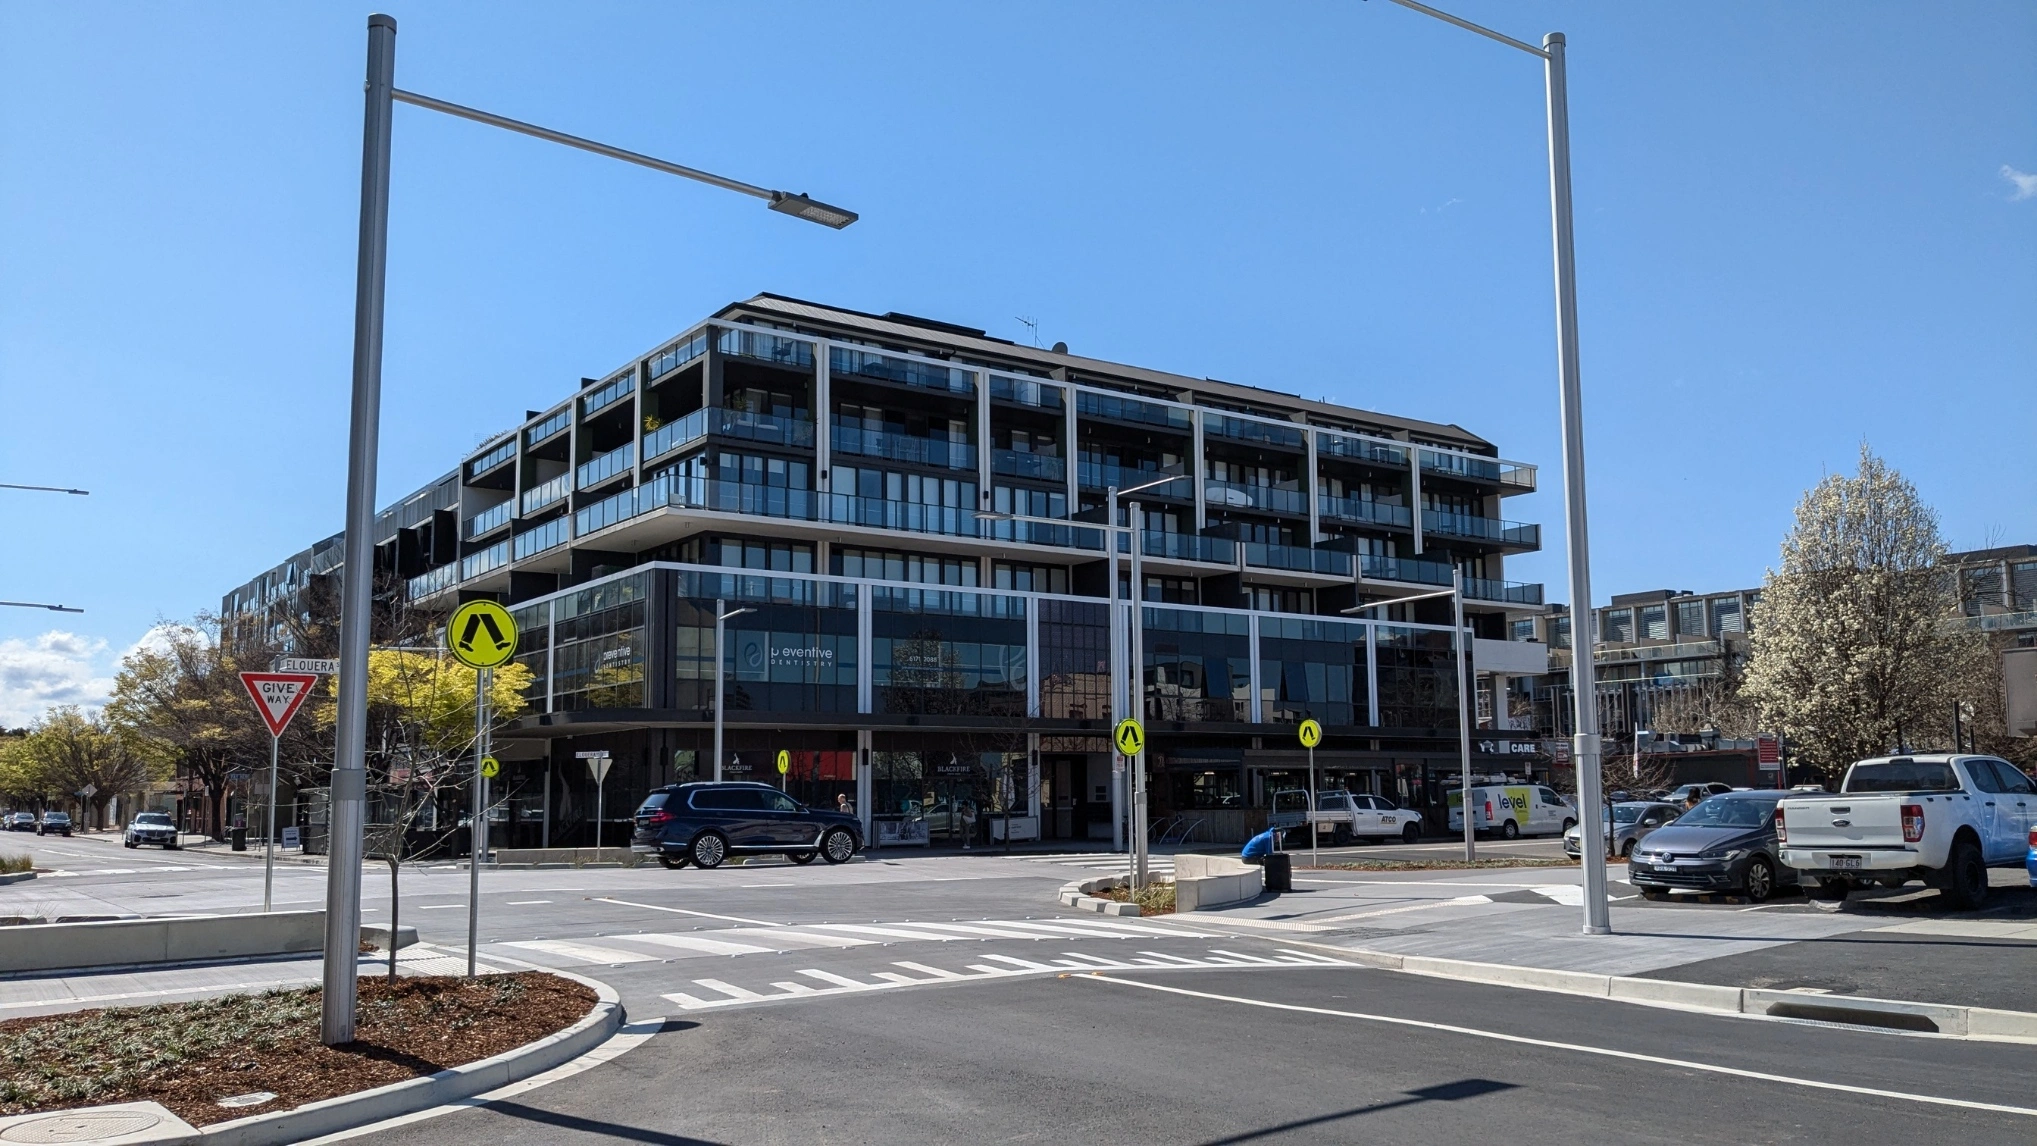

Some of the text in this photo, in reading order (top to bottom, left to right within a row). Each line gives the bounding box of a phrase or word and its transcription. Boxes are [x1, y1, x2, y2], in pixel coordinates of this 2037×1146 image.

[286, 660, 335, 672] ELOUERA
[262, 683, 295, 694] GIVE
[267, 695, 290, 704] WAY
[1511, 743, 1536, 753] CARE
[1498, 794, 1527, 809] level
[1381, 815, 1397, 823] ATCO
